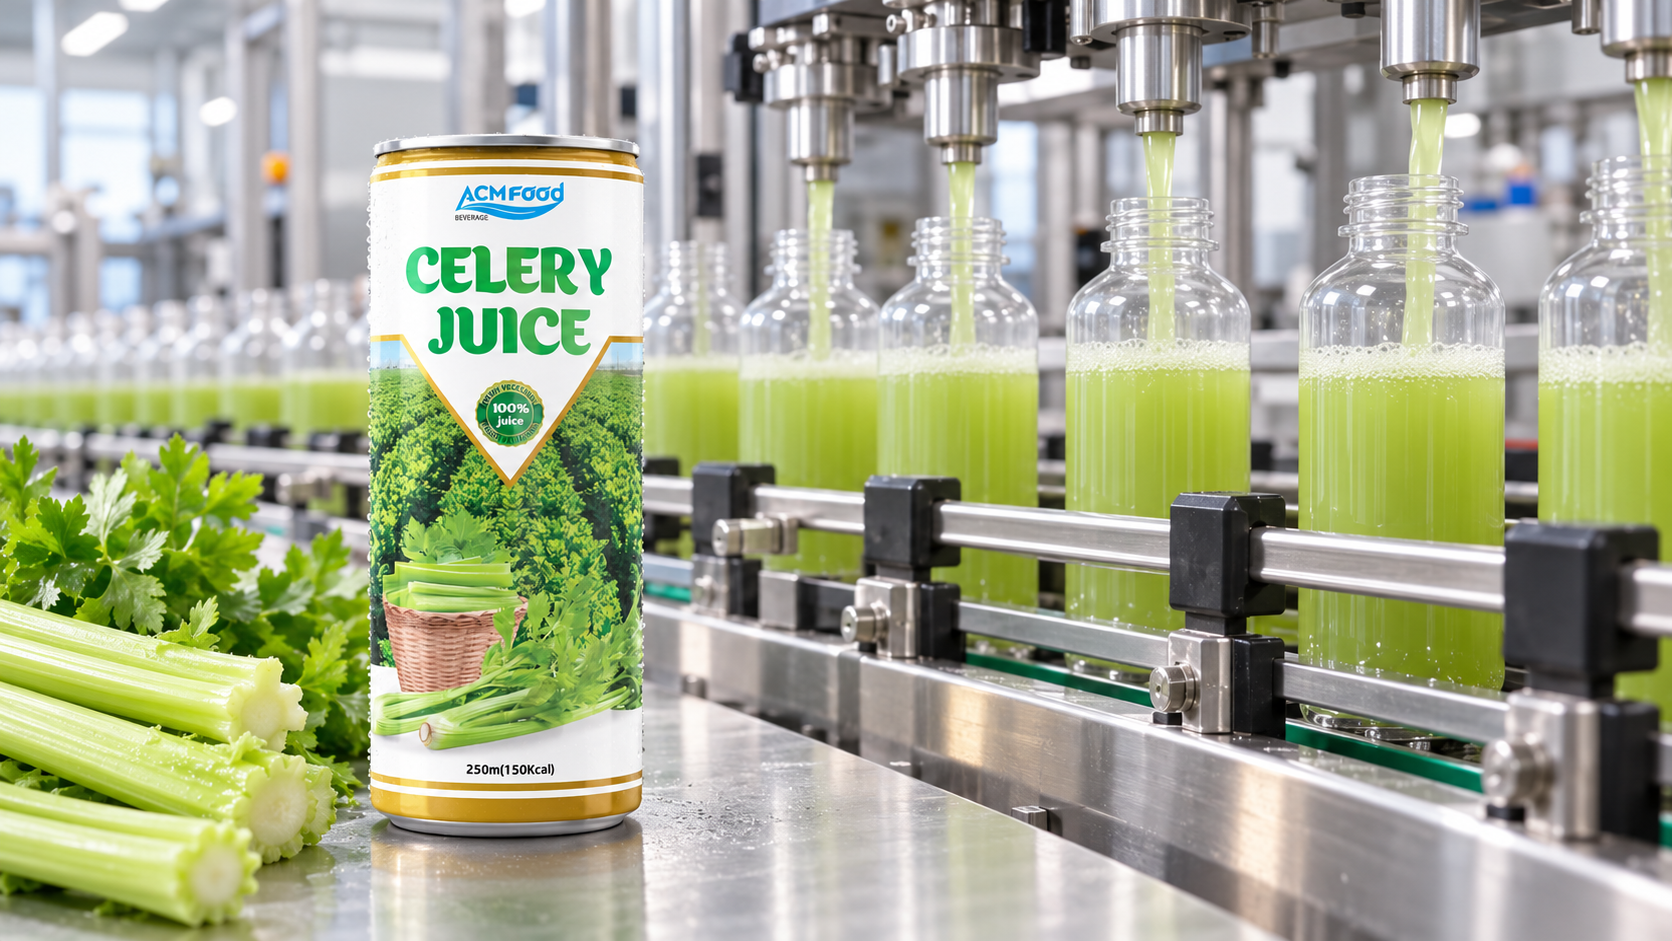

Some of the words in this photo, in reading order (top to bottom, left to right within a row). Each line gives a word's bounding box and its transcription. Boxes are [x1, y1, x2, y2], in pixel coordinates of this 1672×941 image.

[406, 245, 612, 296] CELERY
[428, 306, 591, 355] JUICE
[493, 403, 529, 413] 100%
[496, 416, 524, 428] juice
[466, 764, 555, 776] 250m(150Kcal)
